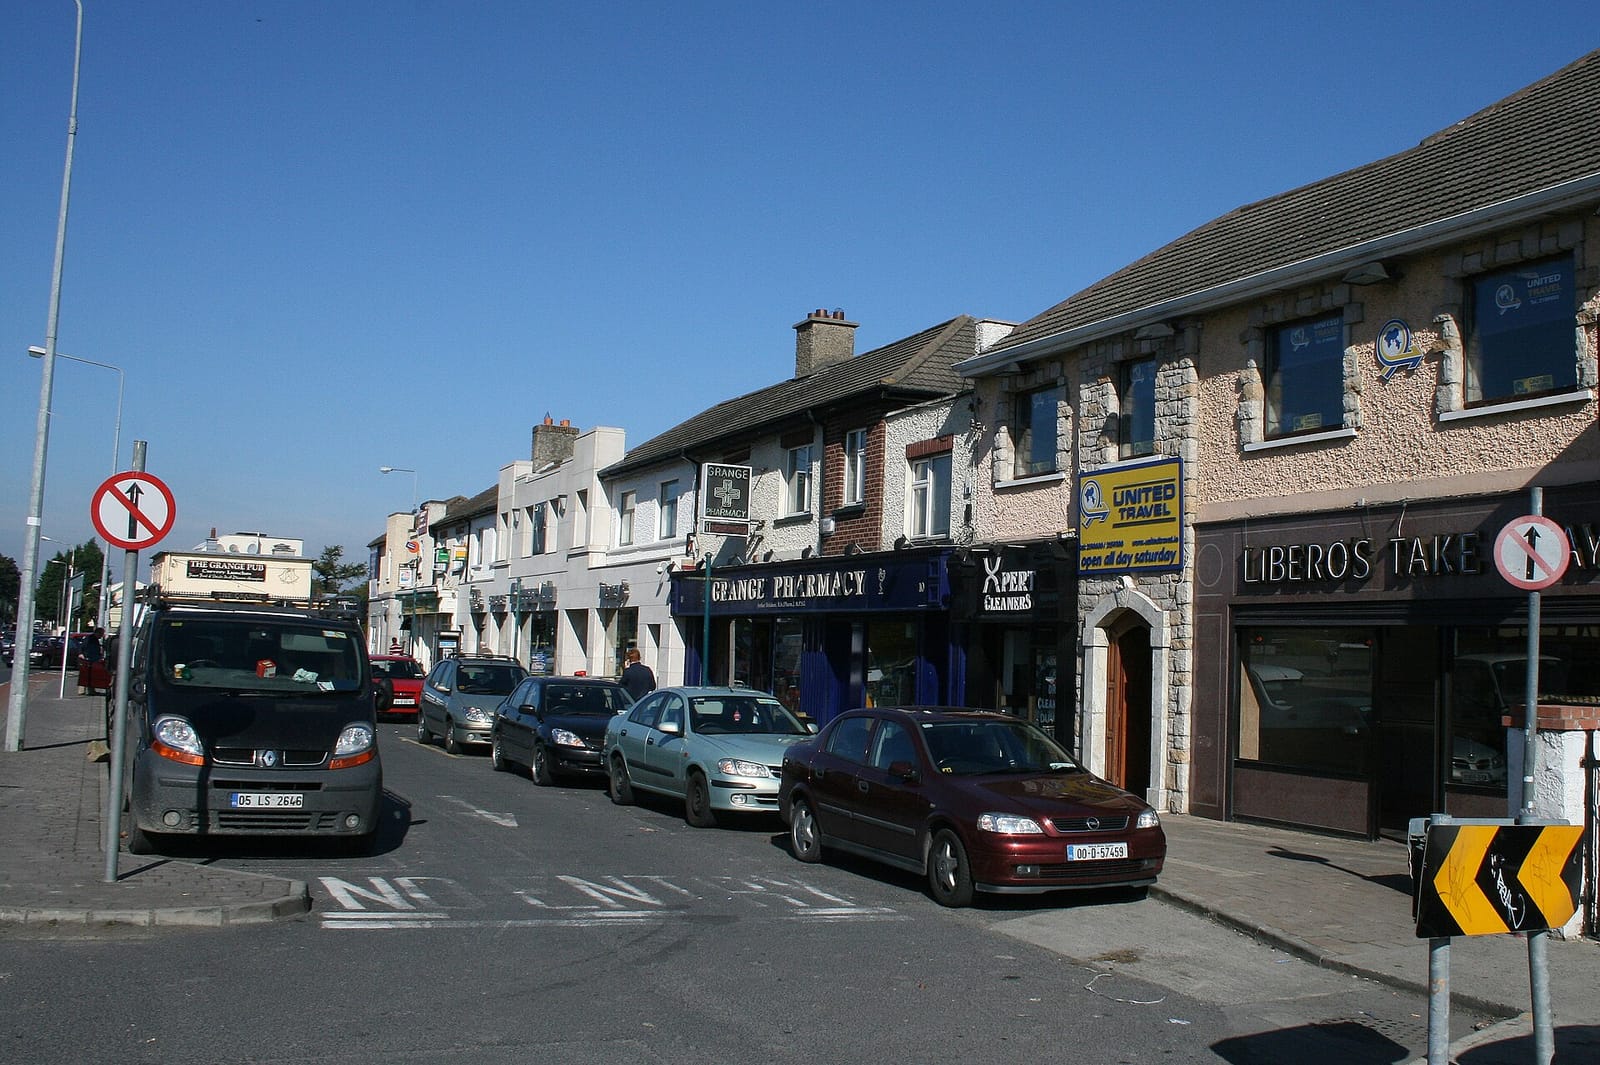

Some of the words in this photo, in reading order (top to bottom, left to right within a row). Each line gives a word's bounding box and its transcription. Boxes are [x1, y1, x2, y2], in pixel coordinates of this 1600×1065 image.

[1527, 273, 1561, 288] UNITED
[708, 466, 748, 479] GRANGE
[1113, 483, 1175, 506] UNITED
[706, 507, 746, 518] PHARMACY
[1119, 503, 1171, 520] TRAVEL
[190, 560, 208, 568] THE
[209, 561, 246, 570] GRANGE
[246, 563, 265, 571] PUB
[1081, 556, 1102, 571] open
[1104, 550, 1116, 566] all
[1116, 551, 1134, 567] day
[1134, 547, 1177, 565] saturday
[1244, 540, 1370, 582] LIBEROS
[1389, 533, 1480, 575] TAKE
[982, 556, 1035, 593] XPERT
[712, 578, 765, 602] GRANGE
[773, 570, 866, 599] PHARMACY
[984, 593, 1032, 611] CLEANERS
[239, 795, 252, 806] 05
[258, 795, 271, 806] LS
[277, 795, 302, 806] 2646
[1077, 846, 1124, 859] 00-D-57459
